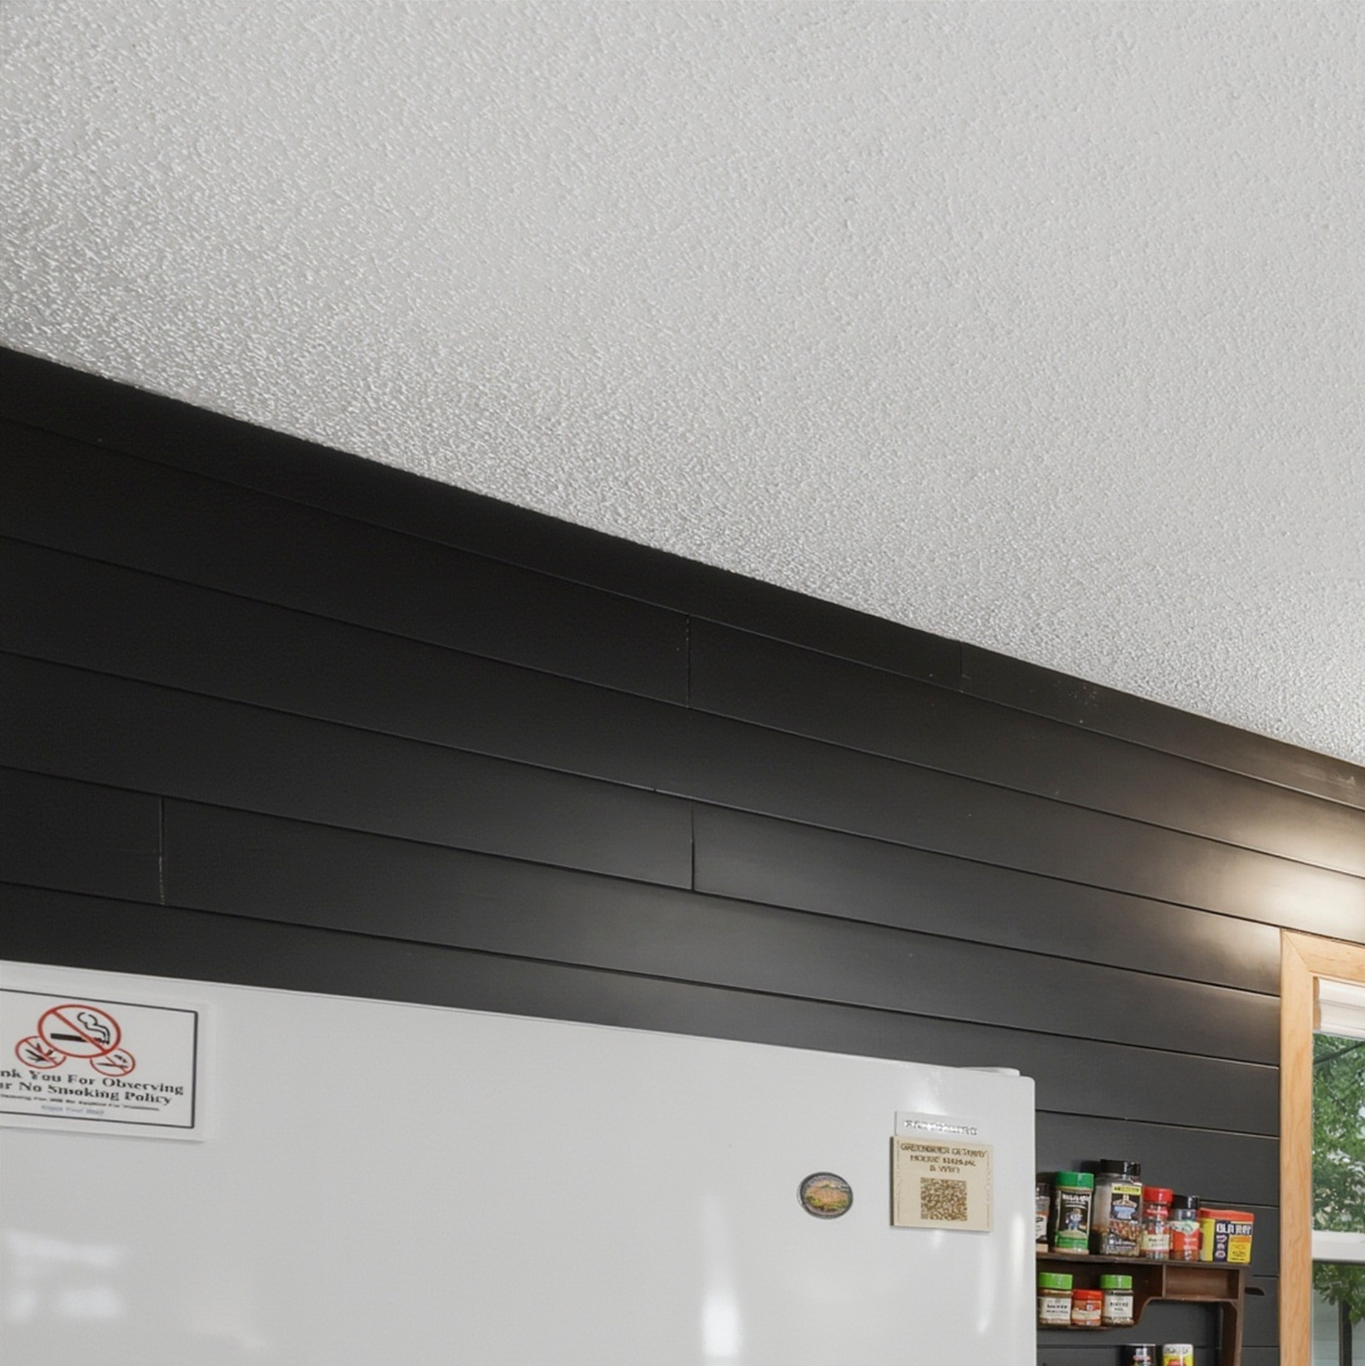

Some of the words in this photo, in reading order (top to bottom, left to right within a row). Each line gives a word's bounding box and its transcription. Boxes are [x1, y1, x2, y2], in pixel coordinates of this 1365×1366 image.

[19, 1082, 42, 1092] No
[47, 1084, 120, 1101] Smoking
[124, 1091, 171, 1106] Policy
[28, 1070, 61, 1083] You
[67, 1074, 96, 1085] For
[102, 1077, 184, 1096] Observing
